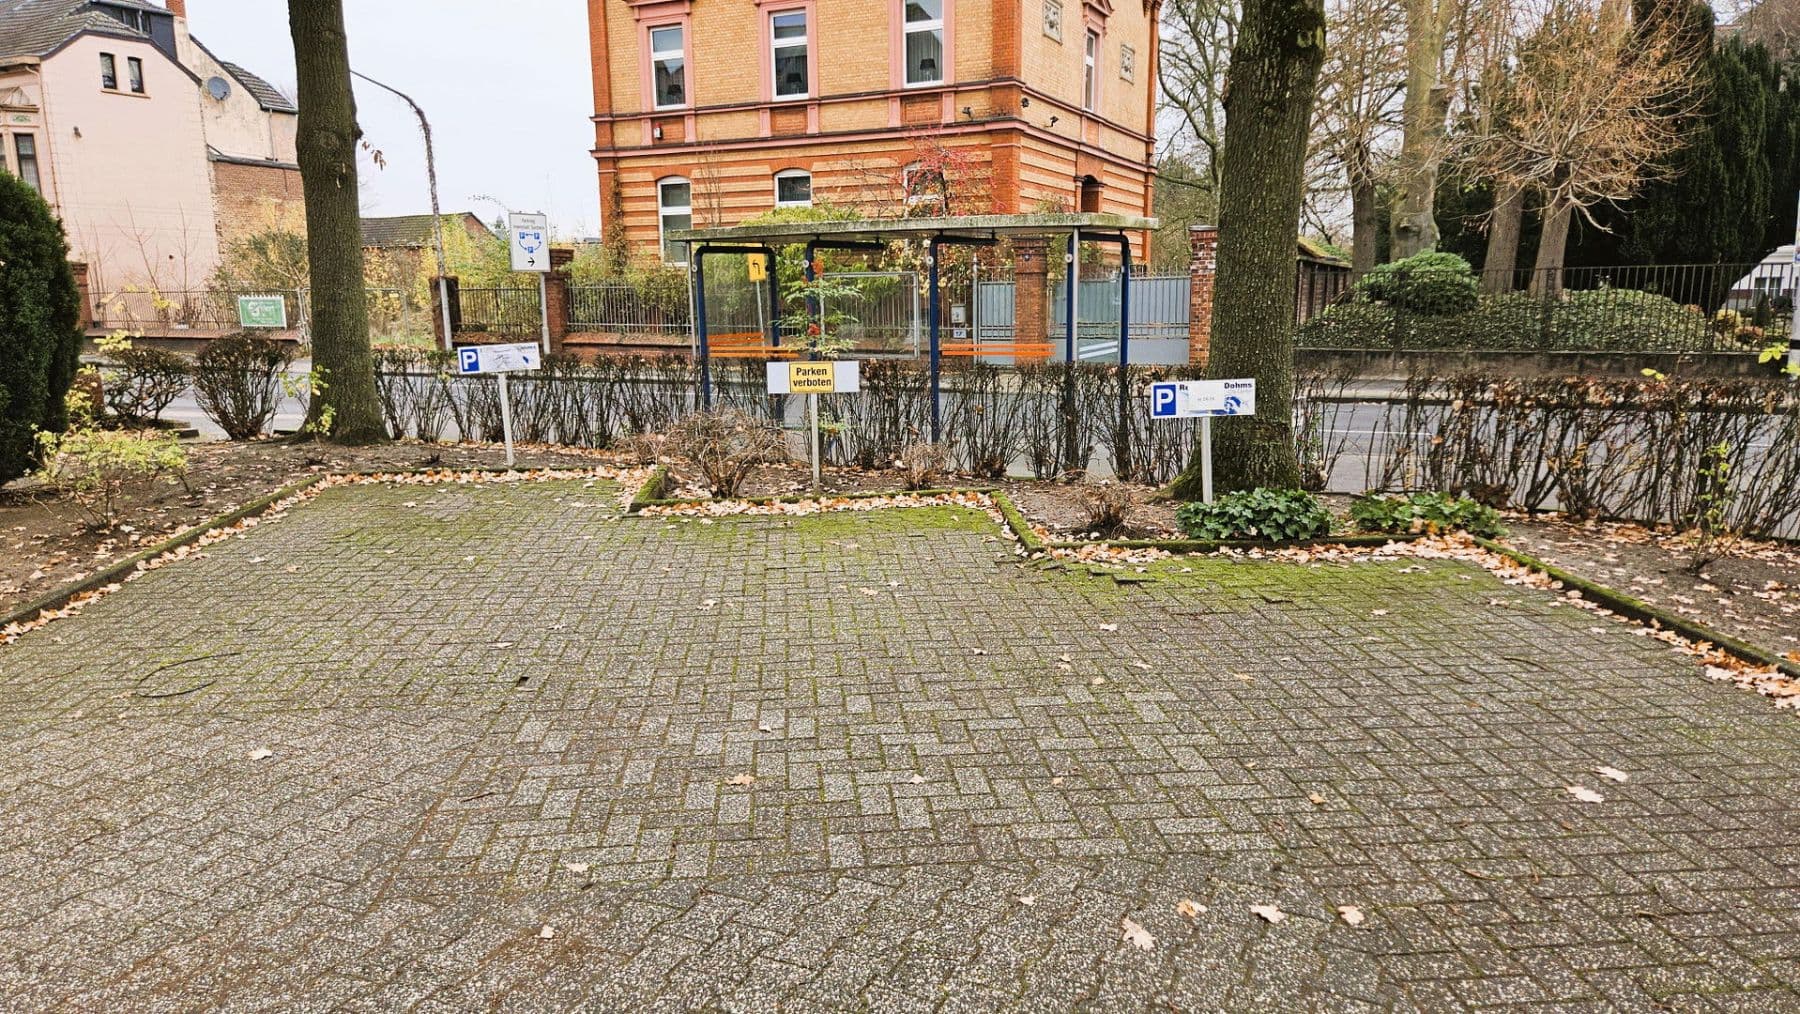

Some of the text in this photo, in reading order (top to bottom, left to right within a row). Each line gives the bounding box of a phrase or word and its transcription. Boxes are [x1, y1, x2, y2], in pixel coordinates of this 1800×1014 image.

[462, 351, 477, 370] P
[796, 367, 827, 376] Parken
[793, 378, 832, 387] verboten
[1155, 388, 1174, 412] P
